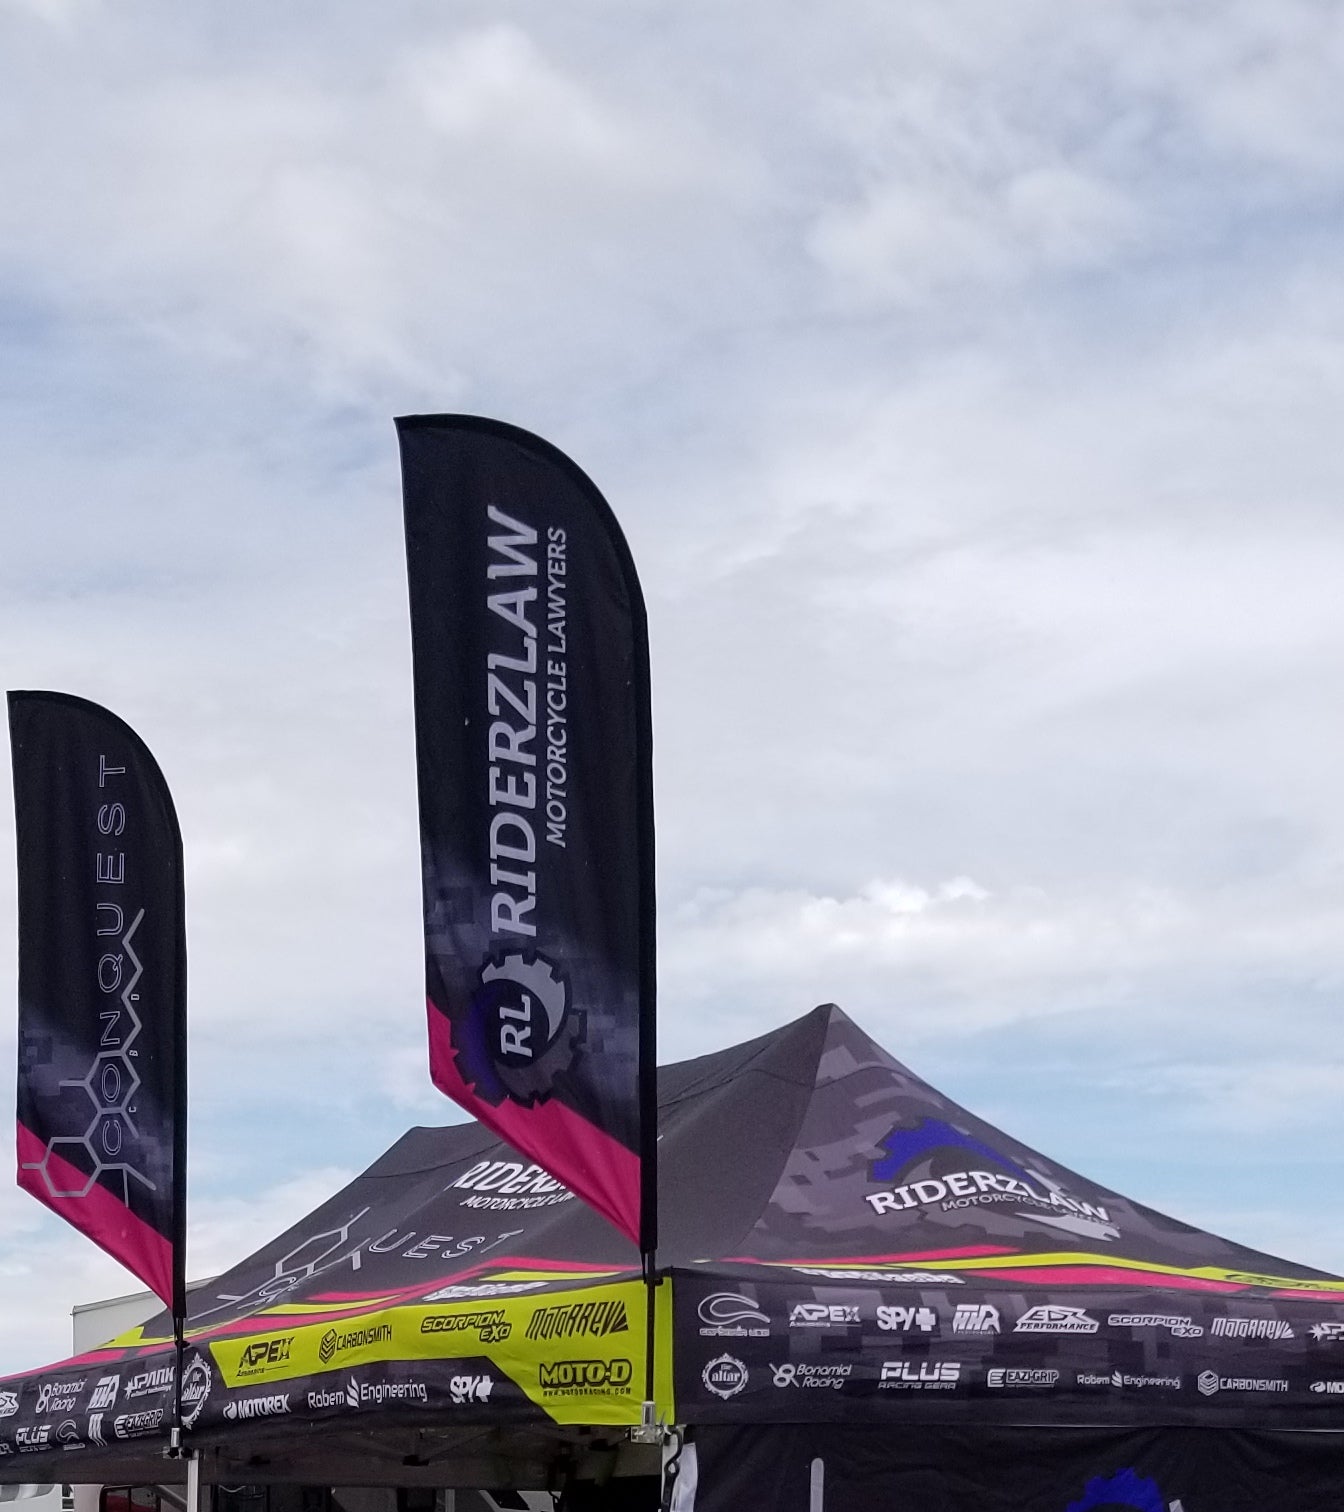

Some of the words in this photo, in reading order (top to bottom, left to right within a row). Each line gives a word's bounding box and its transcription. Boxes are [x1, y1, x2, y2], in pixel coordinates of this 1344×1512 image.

[546, 526, 568, 656] LAWYERS
[486, 503, 539, 938] RIDERZLAW
[545, 662, 568, 849] MOTORCYCLE
[96, 754, 126, 1157] CONQUEST
[500, 993, 532, 1058] RL
[865, 1170, 1110, 1221] RIDERZLAW
[789, 1303, 861, 1323] APEX
[1108, 1314, 1192, 1327] SCORPION
[1019, 1321, 1097, 1332] PERFORMANCE
[239, 1336, 295, 1368] APEX
[421, 1310, 505, 1333] SCORPION
[1171, 1325, 1204, 1338] EXO
[540, 1359, 632, 1388] MOTO-D
[802, 1376, 845, 1390] Racing
[881, 1361, 961, 1381] PLUS
[1077, 1374, 1111, 1385] Robem
[1124, 1375, 1181, 1390] Engineering
[1220, 1378, 1288, 1393] CARBONSMITH
[308, 1388, 345, 1409] Robem
[361, 1379, 428, 1403] Engineering
